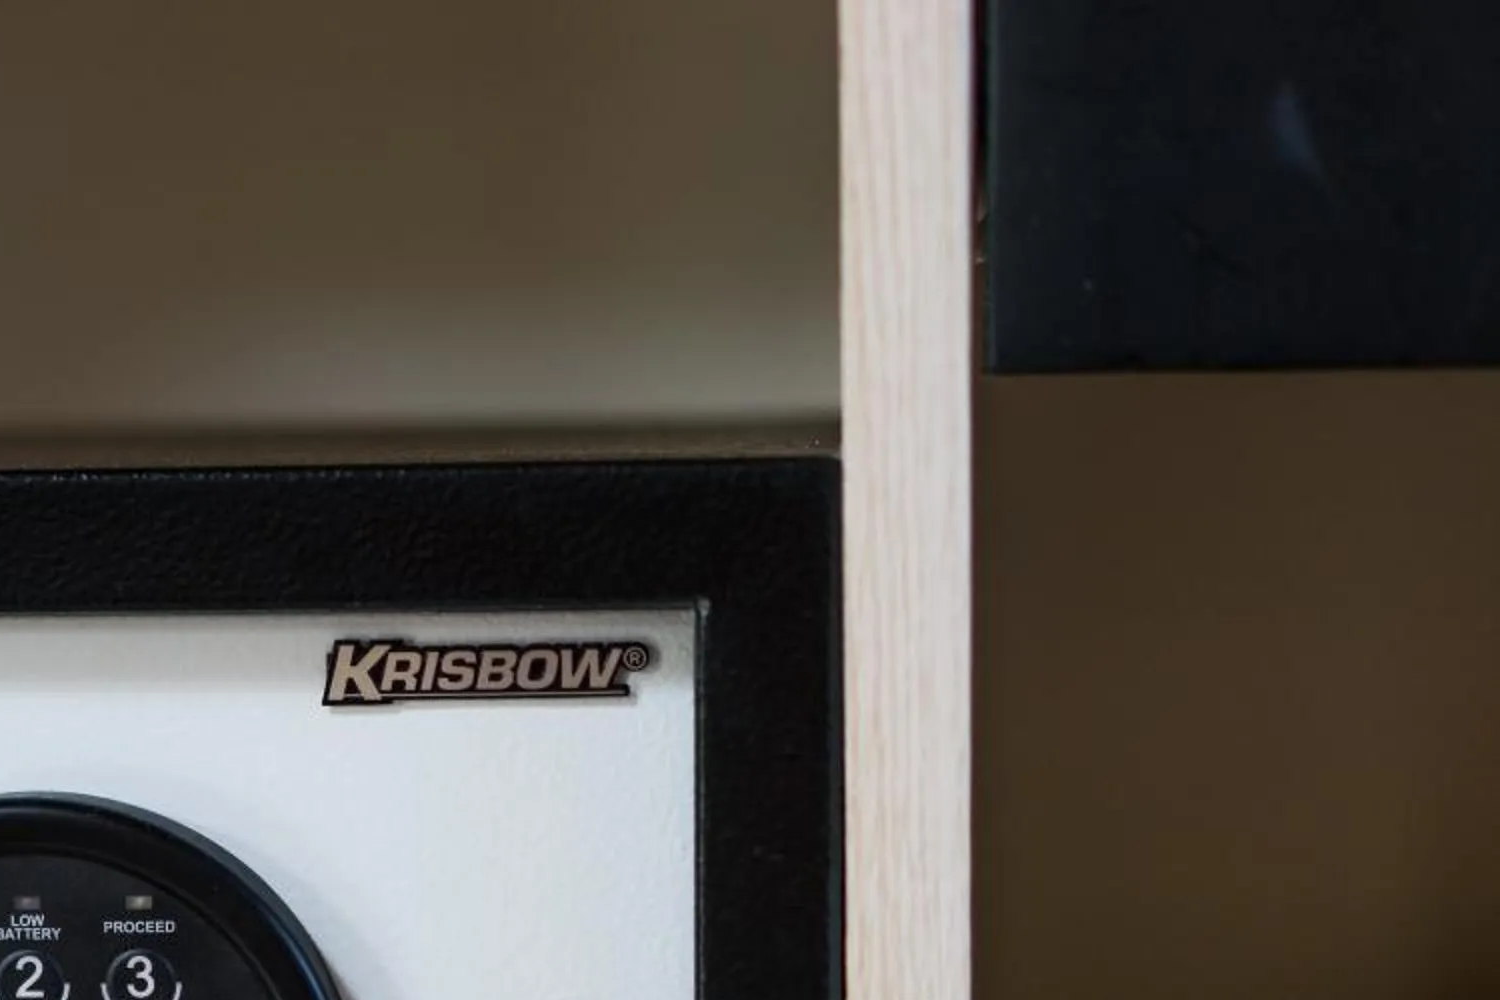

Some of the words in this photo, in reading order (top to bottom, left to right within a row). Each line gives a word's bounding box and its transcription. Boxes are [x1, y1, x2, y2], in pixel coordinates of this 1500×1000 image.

[11, 914, 45, 927] LOW
[103, 921, 175, 933] PROCEED
[15, 955, 45, 999] 2
[126, 955, 155, 999] 3
